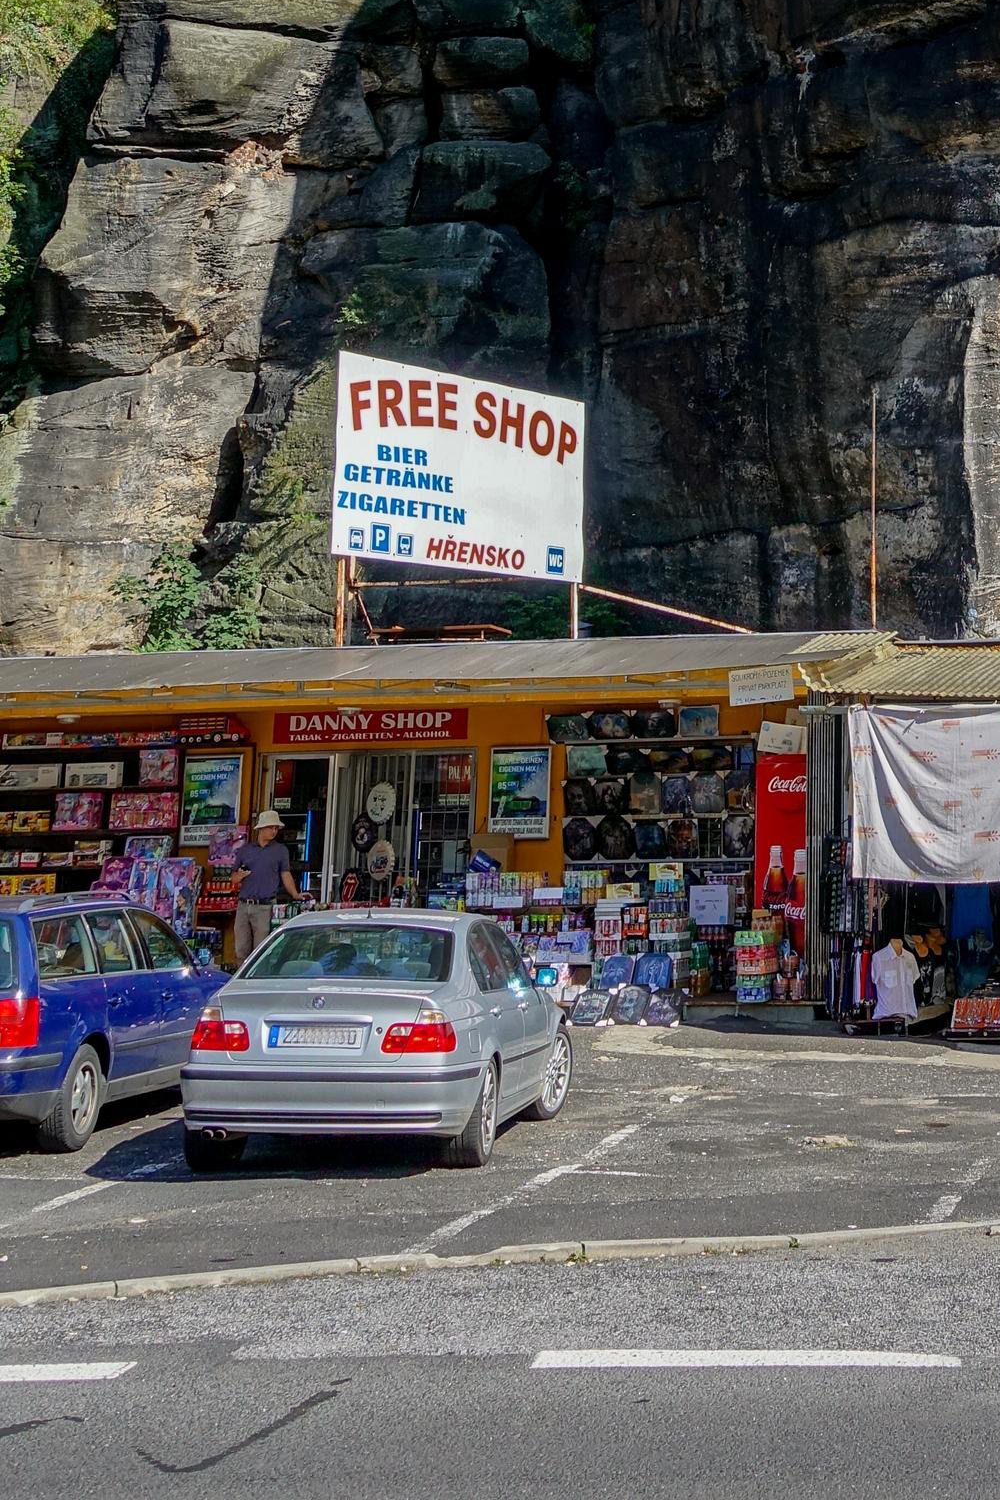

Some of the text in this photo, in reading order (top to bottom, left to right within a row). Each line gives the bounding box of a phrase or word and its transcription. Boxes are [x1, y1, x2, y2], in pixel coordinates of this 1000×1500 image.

[350, 380, 577, 465] FREE SHOP
[377, 444, 428, 466] BIER
[344, 463, 454, 493] GETRÄNKE
[337, 490, 466, 525] ZIGARETTEN
[374, 528, 386, 547] P
[426, 535, 525, 570] HŘENSKO
[548, 553, 563, 568] WC
[289, 711, 452, 732] DANNY SHOP
[289, 730, 452, 741] TABAK ZIGARETTEN ALKOHOL
[497, 781, 507, 790] 85
